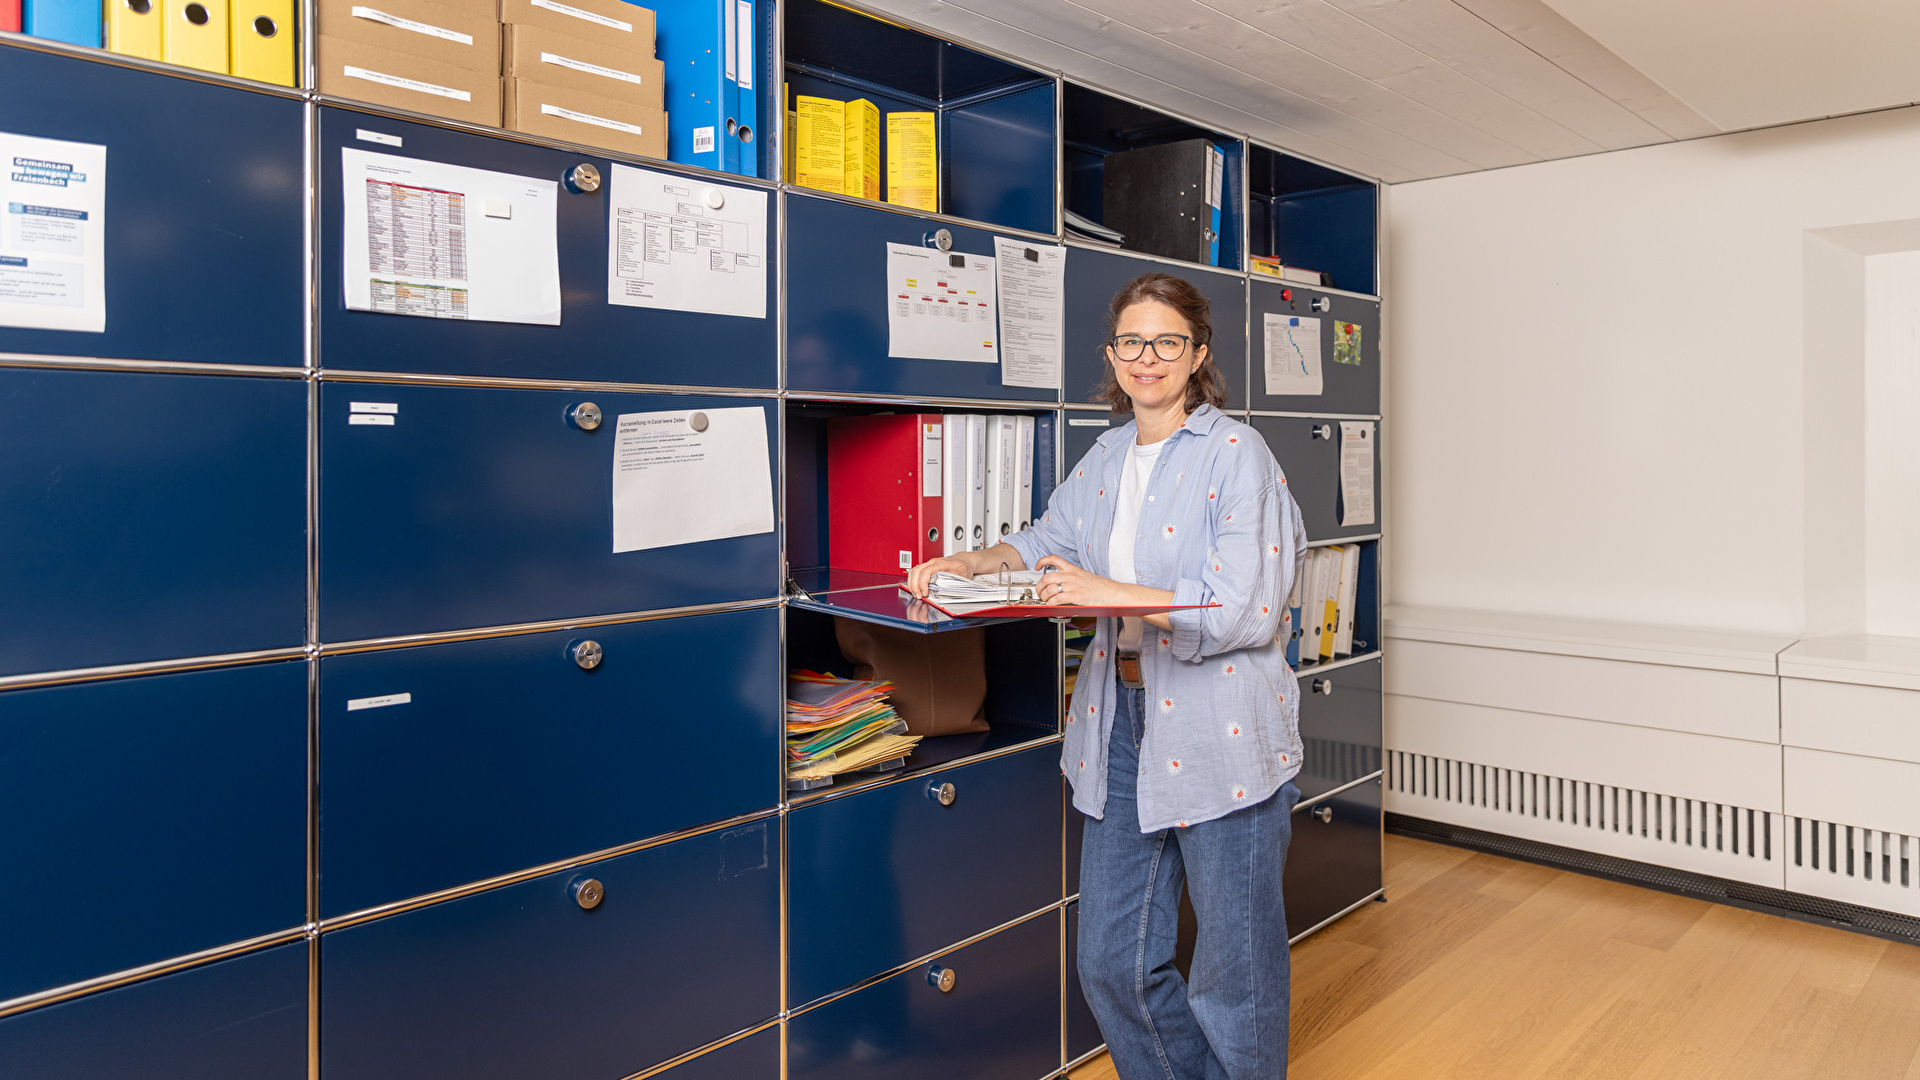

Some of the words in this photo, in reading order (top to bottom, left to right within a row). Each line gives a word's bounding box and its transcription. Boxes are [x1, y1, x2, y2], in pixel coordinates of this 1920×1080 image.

[15, 158, 71, 171] Gemeinsam
[13, 174, 66, 186] Freienbach
[25, 167, 68, 179] bewegen
[69, 172, 86, 181] wir
